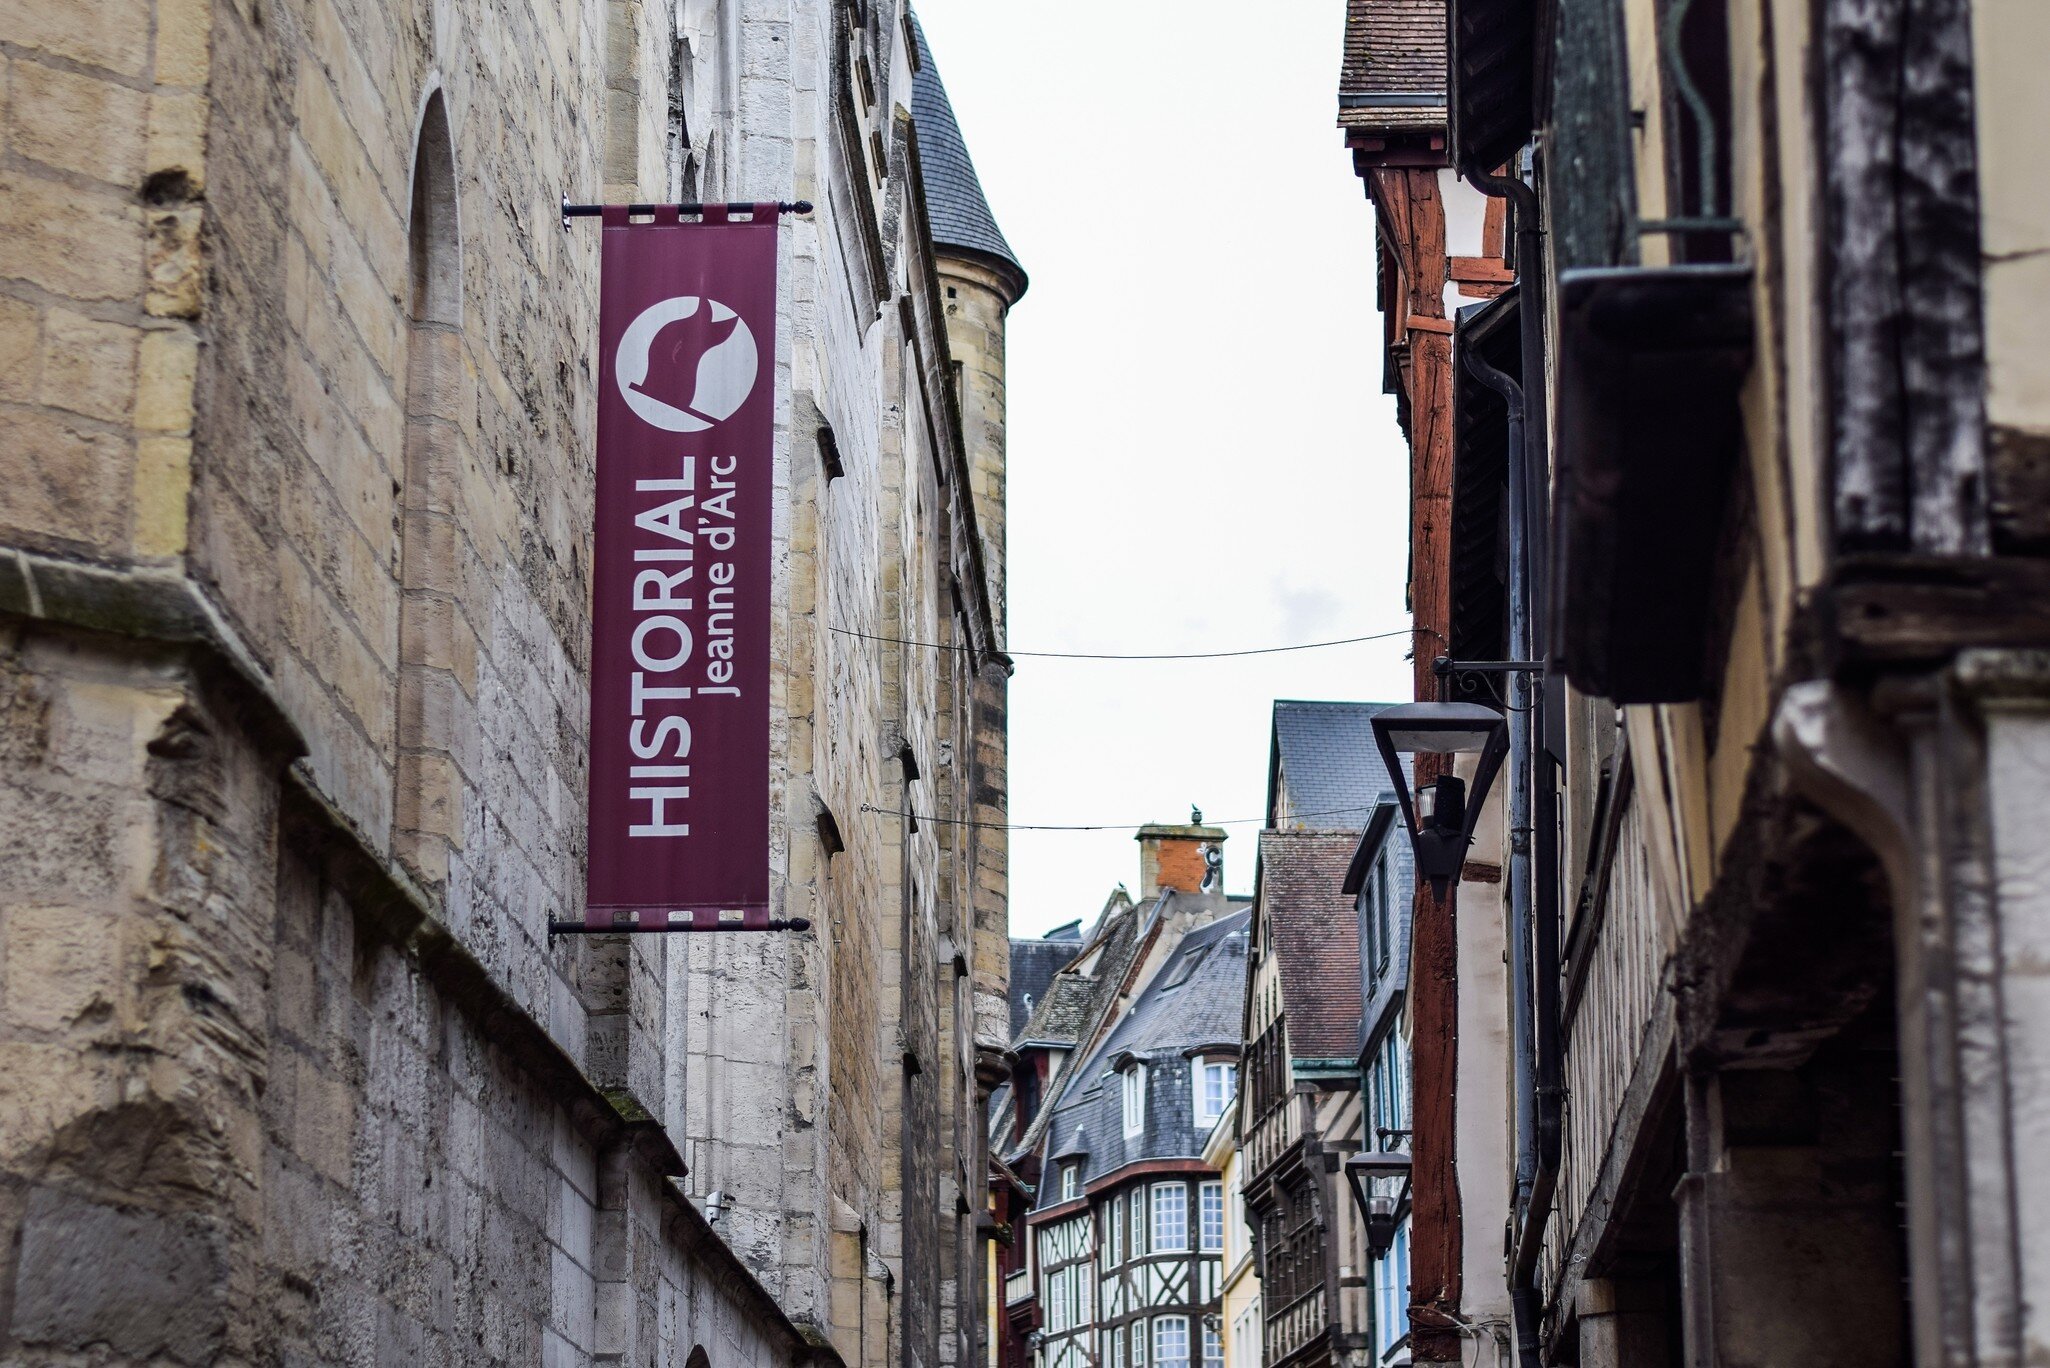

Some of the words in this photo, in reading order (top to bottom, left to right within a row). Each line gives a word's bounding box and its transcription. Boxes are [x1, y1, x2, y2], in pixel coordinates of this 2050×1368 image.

[698, 455, 737, 550] d'Arc
[629, 456, 696, 837] HISTORIAL
[697, 562, 741, 698] Jeanne
